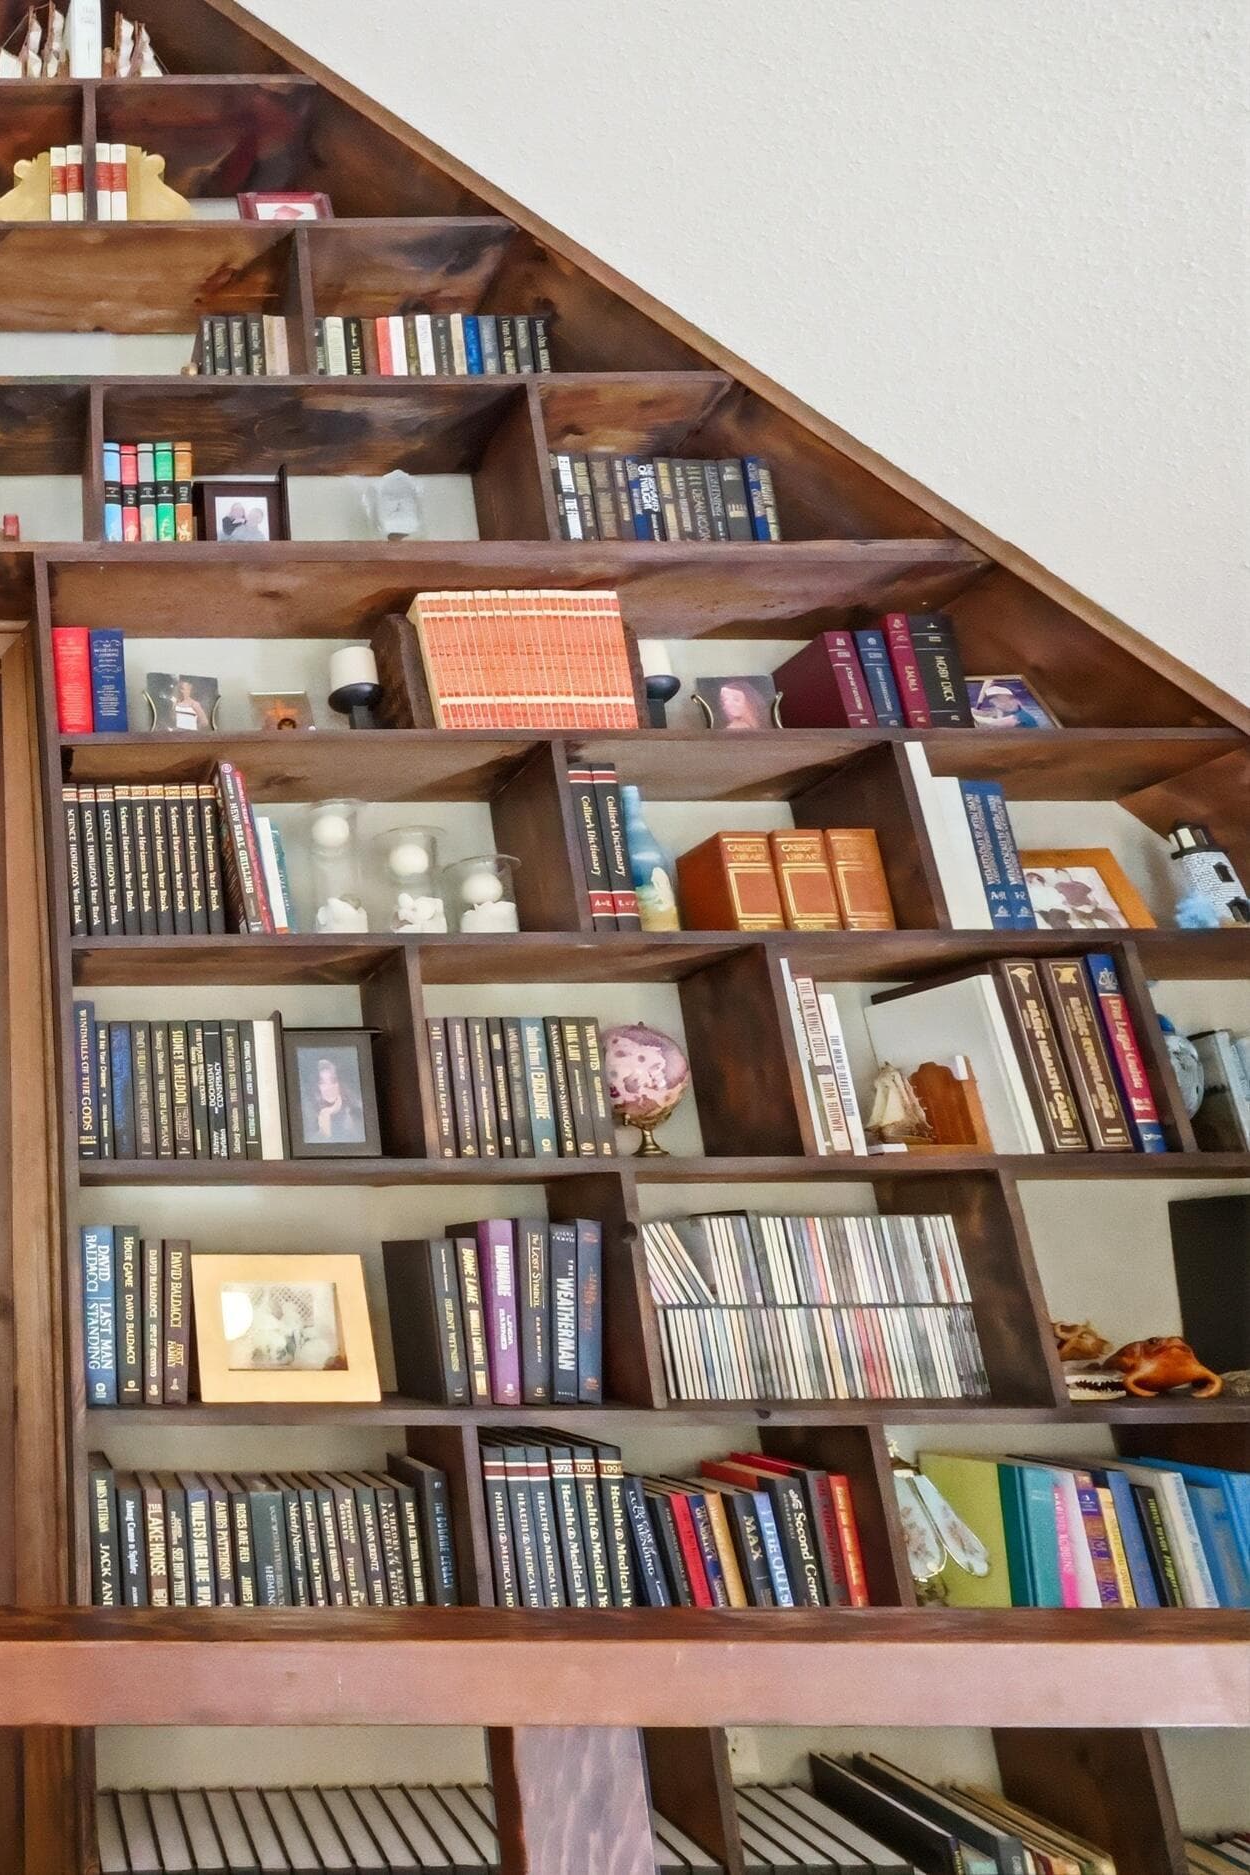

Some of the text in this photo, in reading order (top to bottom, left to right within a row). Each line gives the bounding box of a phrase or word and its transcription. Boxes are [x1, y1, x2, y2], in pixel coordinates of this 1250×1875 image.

[933, 655, 956, 702] MOBY DICK
[66, 808, 76, 840] SCIENCE
[83, 809, 94, 842] SCIENCE
[102, 808, 112, 840] SCIENCE
[119, 806, 129, 835] Science
[579, 795, 602, 877] Collier's Dictionary
[604, 795, 627, 877] Collier's Dictionary
[68, 843, 80, 887] HORIZONS
[86, 844, 97, 887] HORIZONS
[104, 843, 115, 886] HORIZONS
[169, 806, 179, 835] Science
[174, 872, 183, 889] Year
[203, 805, 213, 833] Science
[208, 871, 217, 888] Year
[123, 872, 133, 889] Year
[1024, 998, 1048, 1039] BASIC
[1067, 996, 1092, 1036] BASIC
[78, 1007, 92, 1131] WINDMILLS OF THE GODS
[170, 1029, 187, 1104] SIDNEY SHELDON
[529, 1071, 551, 1120] EXCLUSIVE
[84, 1234, 97, 1292] BALDACCI
[96, 1244, 110, 1281] DAVID
[122, 1236, 134, 1287] HOUR GAME
[148, 1249, 158, 1318] DAVID BALDACCI
[460, 1247, 479, 1304] BONE LAKE
[493, 1244, 513, 1297] HARDWARE
[530, 1245, 541, 1271] LOST
[169, 1251, 182, 1328] DAVID BALDACCI
[530, 1271, 543, 1308] SYMBOL
[86, 1302, 100, 1370] STANDING
[99, 1303, 113, 1370] LAST MAN
[124, 1294, 135, 1364] DAVID BALDACCI
[553, 1277, 577, 1371] WEATHERMAN
[124, 1499, 135, 1521] Along
[126, 1521, 136, 1542] Came
[147, 1511, 163, 1541] LAKE
[235, 1502, 250, 1563] ROSES ARE RED
[791, 1511, 814, 1560] Second
[98, 1542, 111, 1578] JACK
[127, 1550, 138, 1575] Spider
[148, 1542, 165, 1576] HOUSE
[189, 1500, 210, 1583] VIOLETS ARE BLUE
[213, 1500, 230, 1580] JAMES PATTERSON
[492, 1491, 513, 1590] HEALTH MEDICAL
[515, 1492, 537, 1591] HEALTH MEDICAL
[536, 1491, 558, 1590] HEALTH MEDICAL
[560, 1483, 584, 1593] Health Medical
[583, 1483, 607, 1593] Health Medical
[608, 1485, 631, 1594] Health Medical
[741, 1514, 764, 1561] MAX
[240, 1575, 253, 1602] JAMES
